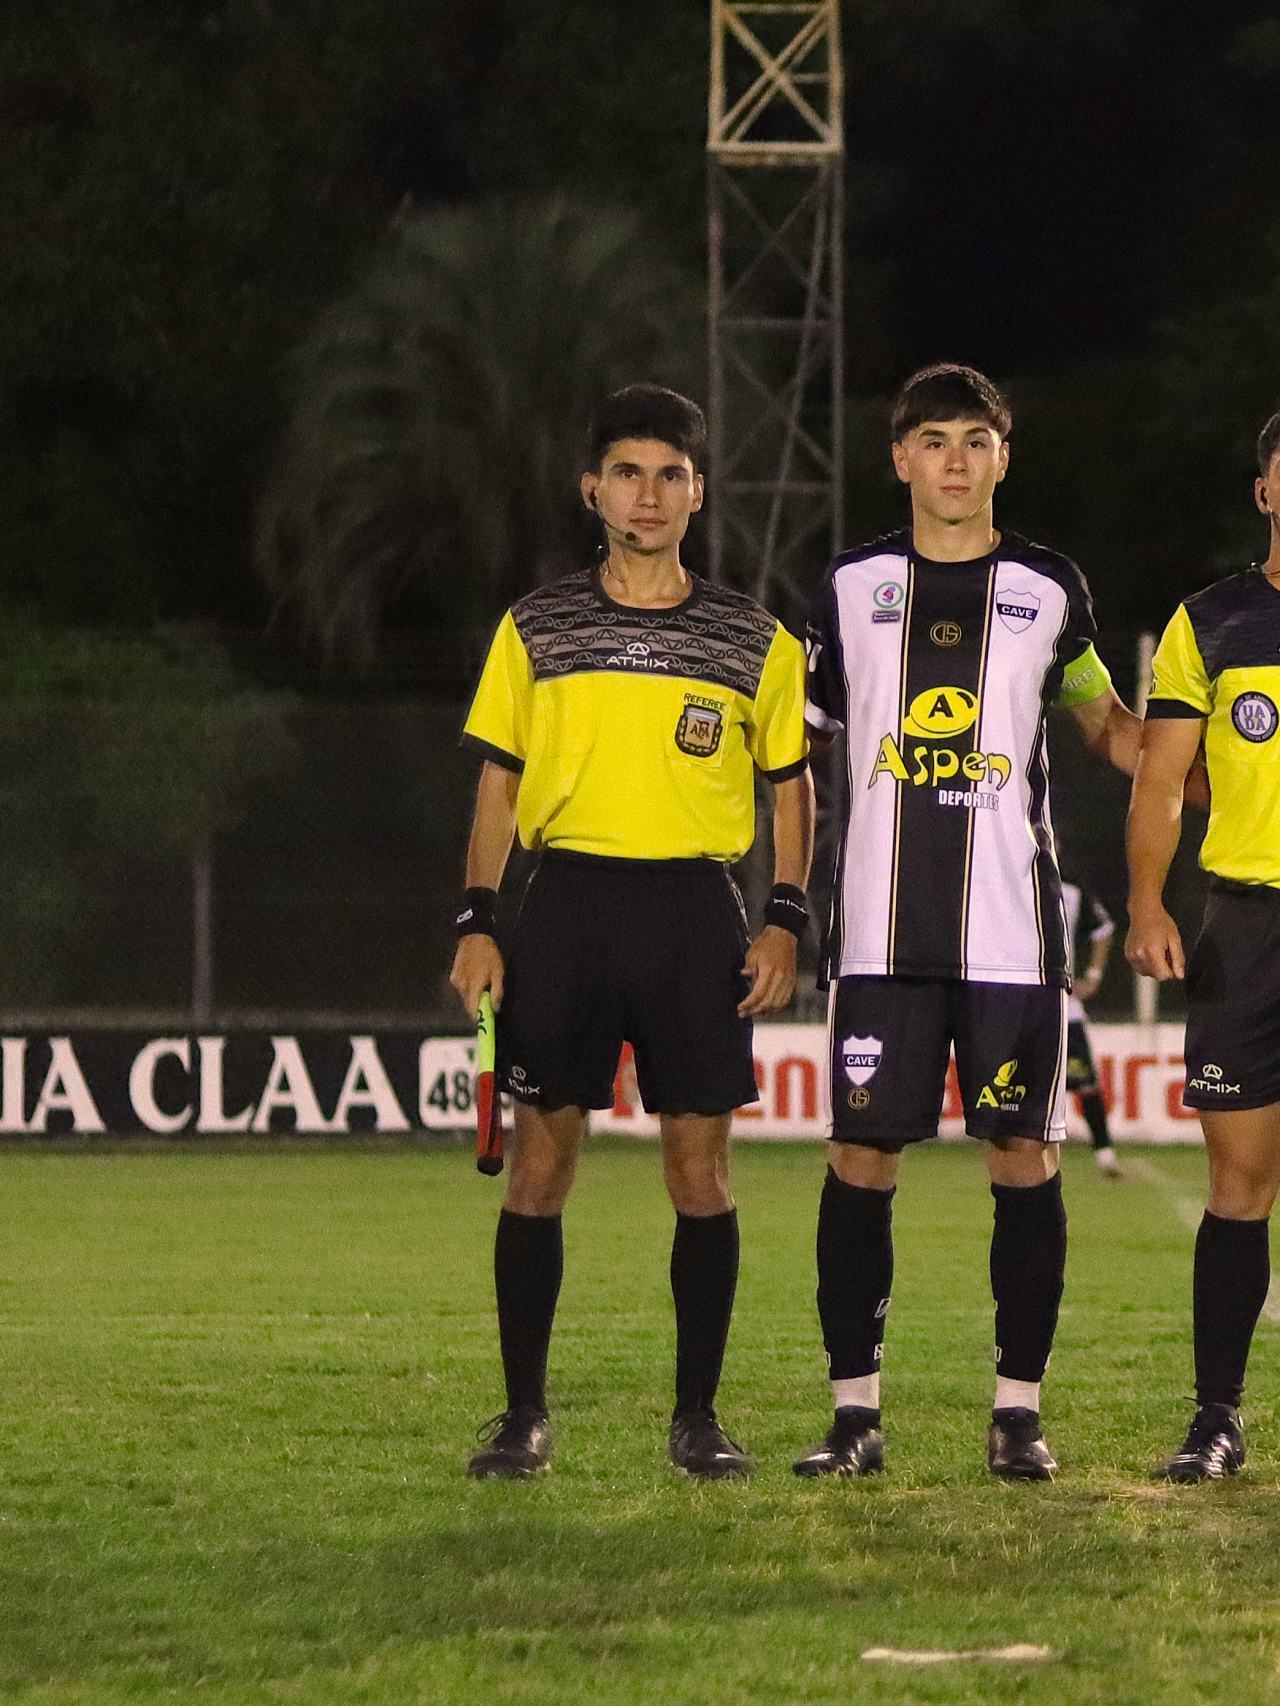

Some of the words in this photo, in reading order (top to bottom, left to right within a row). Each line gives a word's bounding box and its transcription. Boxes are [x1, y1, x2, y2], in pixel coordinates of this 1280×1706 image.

[1001, 605, 1033, 619] CAVE
[606, 655, 669, 670] ATHIX
[683, 692, 727, 711] REFEREE
[928, 694, 954, 719] A
[867, 732, 1012, 790] Aspen
[938, 789, 1000, 811] DEPORTES
[846, 1055, 876, 1066] CAVE
[128, 1036, 412, 1134] CLAA
[1189, 1078, 1241, 1094] ATHIX
